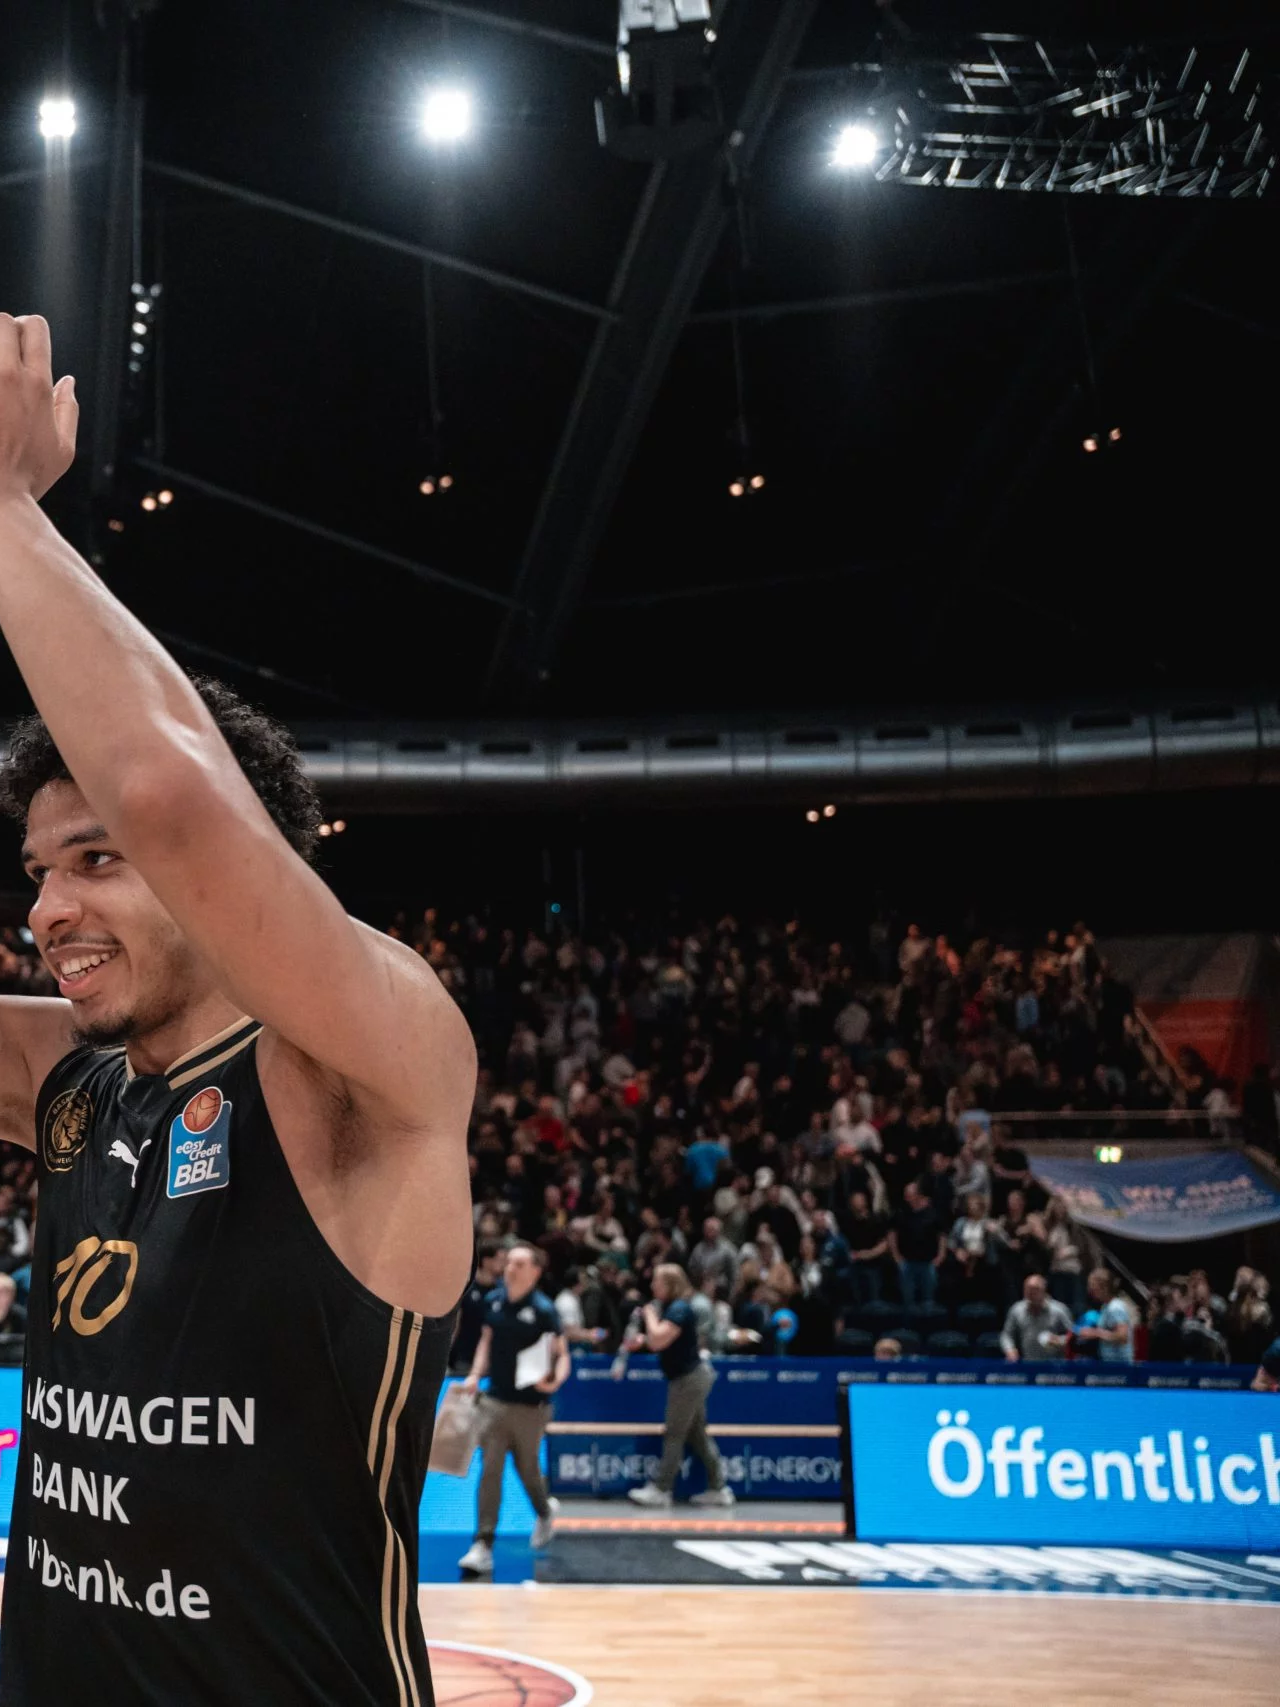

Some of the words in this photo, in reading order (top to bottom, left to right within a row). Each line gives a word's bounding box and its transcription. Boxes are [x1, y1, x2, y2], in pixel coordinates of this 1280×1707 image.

[189, 1143, 222, 1161] Credit
[173, 1157, 220, 1188] BBL
[52, 1236, 138, 1336] 10
[597, 1453, 692, 1481] ENERY
[32, 1452, 131, 1525] BANK
